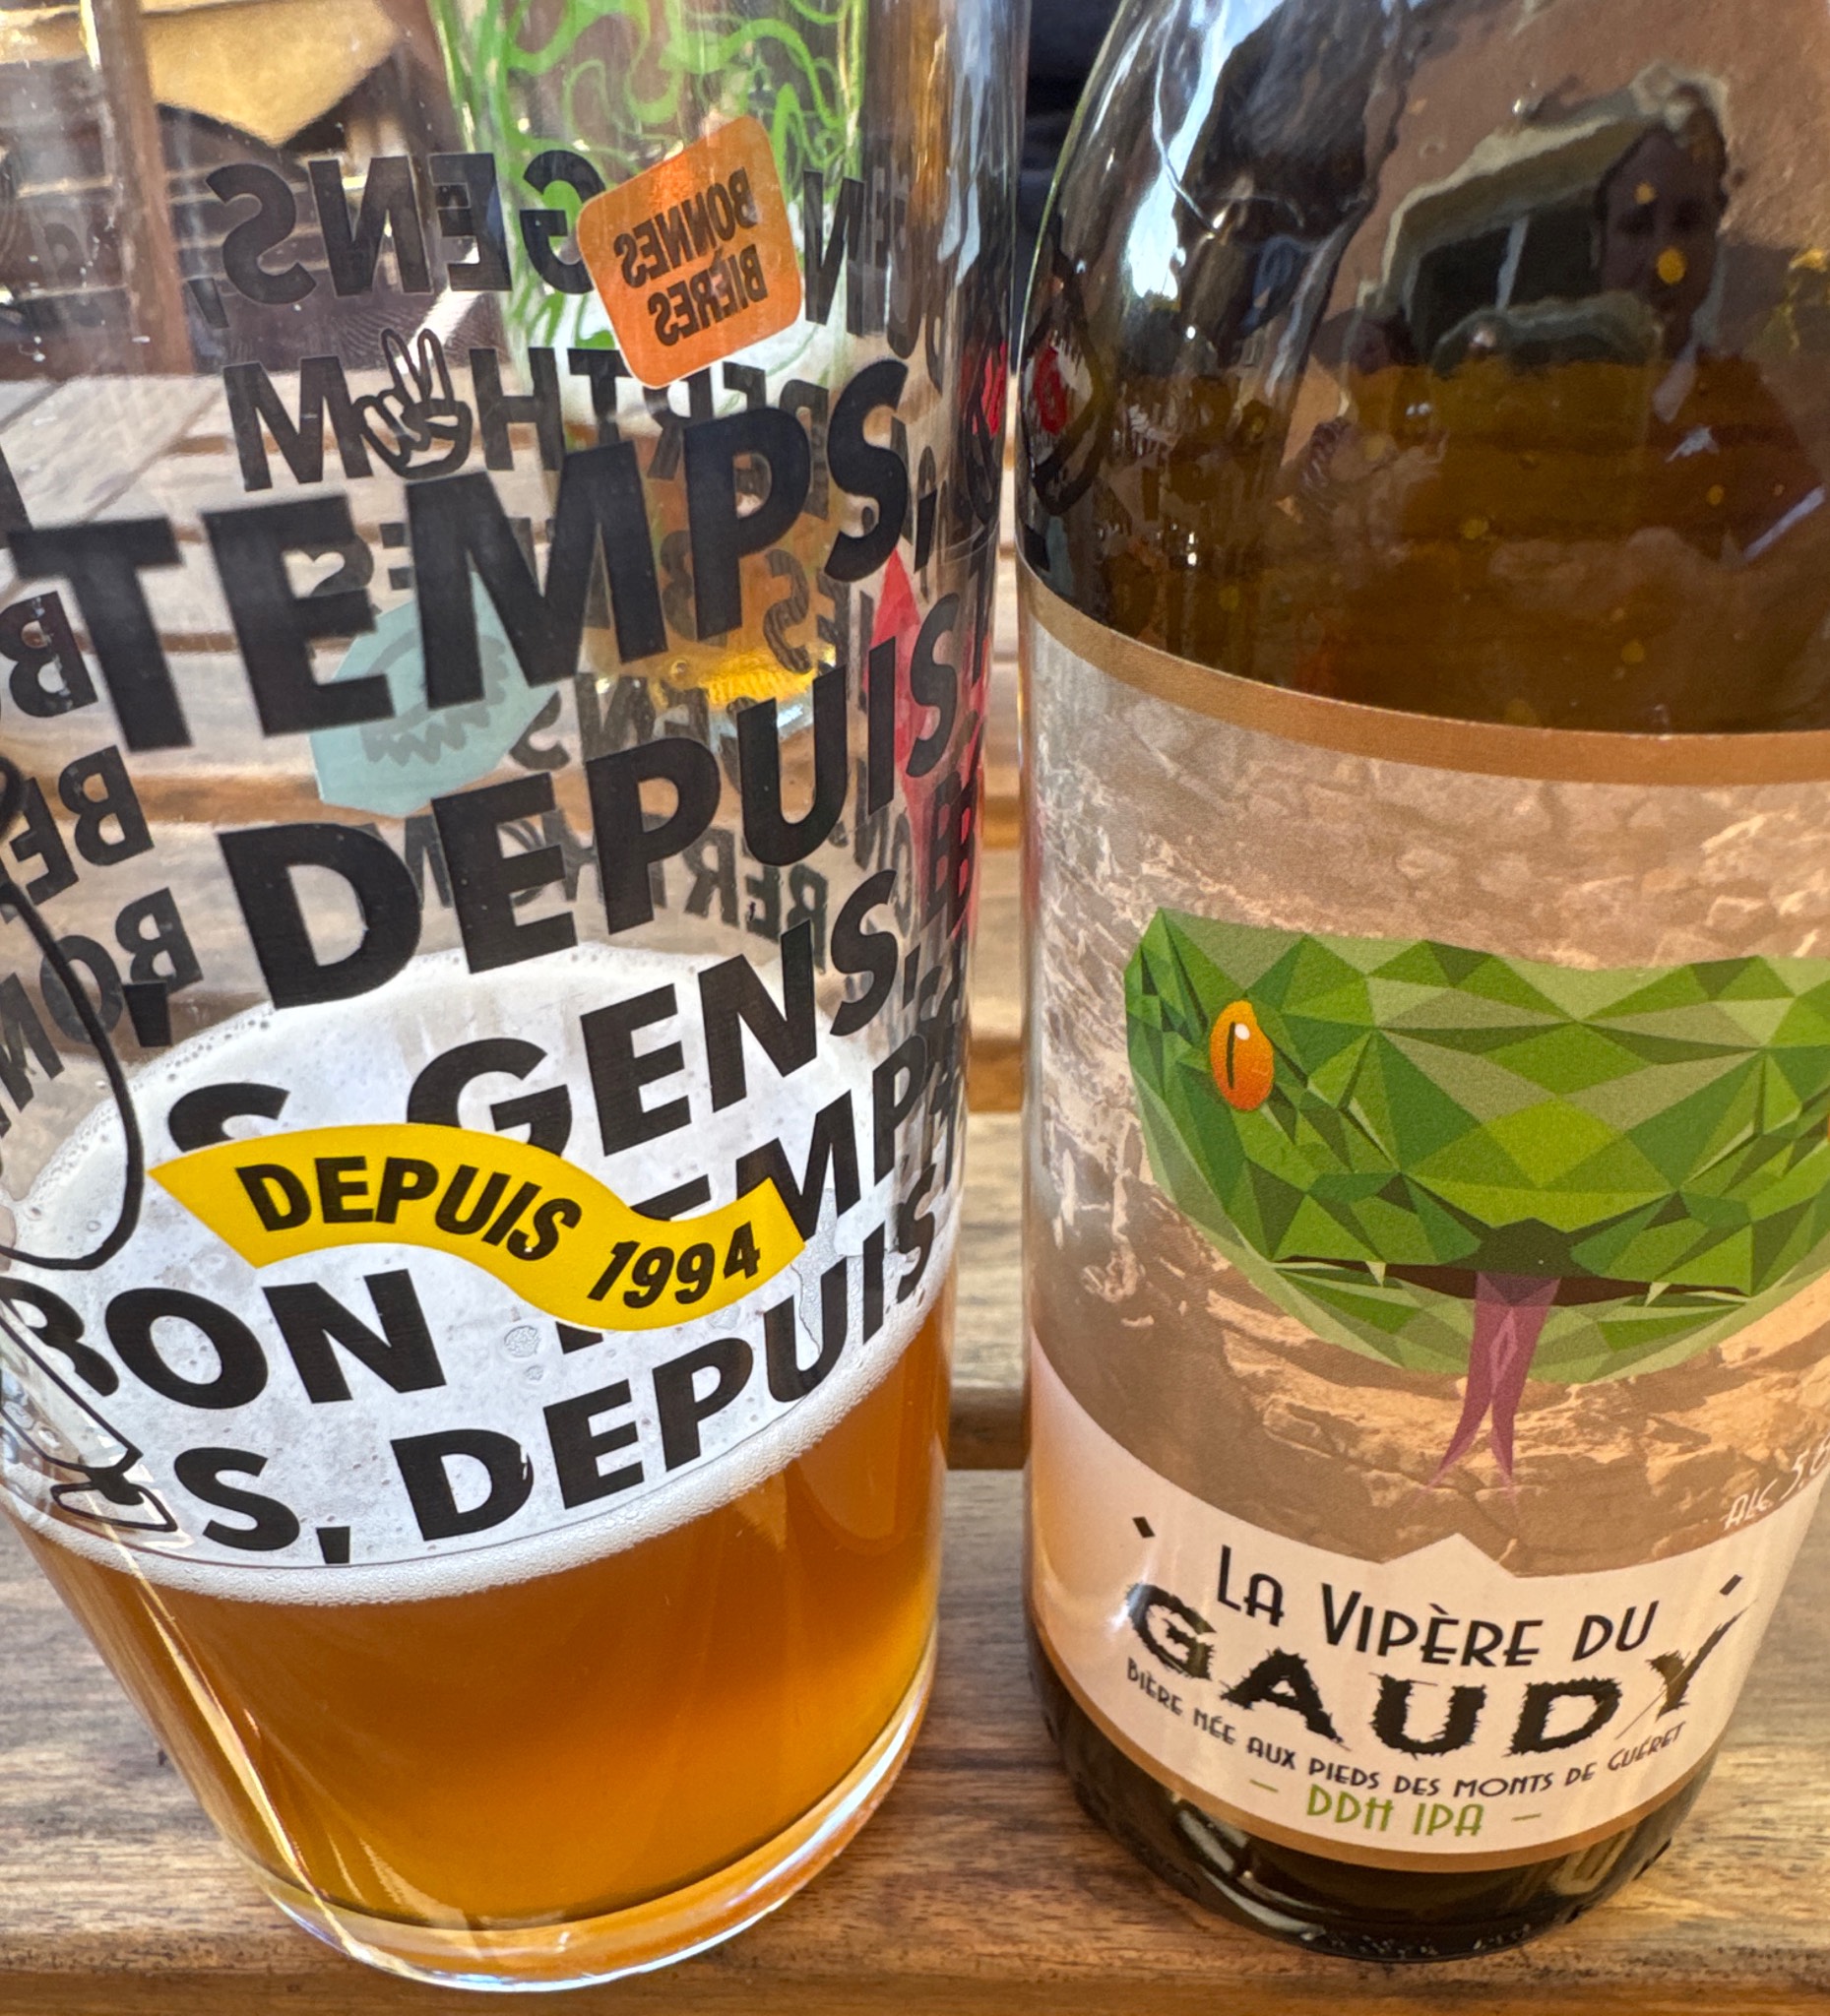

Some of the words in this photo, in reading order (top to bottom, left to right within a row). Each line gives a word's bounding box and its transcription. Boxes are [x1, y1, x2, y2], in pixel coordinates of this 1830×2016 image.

[8, 359, 937, 754] TEMPS,
[218, 592, 960, 1011] DEPUIS
[235, 1156, 583, 1261] DEPUIS
[588, 1222, 762, 1309] 1994
[390, 1163, 936, 1542] DEPUIS
[1125, 1582, 1758, 1760] GAUDY
[1217, 1544, 1286, 1627] LA
[1321, 1583, 1544, 1667] VIPÈRE
[1572, 1600, 1660, 1662] DU
[1246, 1735, 1297, 1770] AUX
[1308, 1757, 1380, 1790] PIEDS
[1393, 1775, 1440, 1796] DES
[1452, 1771, 1554, 1798] MONTS
[1564, 1761, 1598, 1787] DE
[1306, 1783, 1394, 1833] DDH
[1413, 1802, 1484, 1838] IPA
